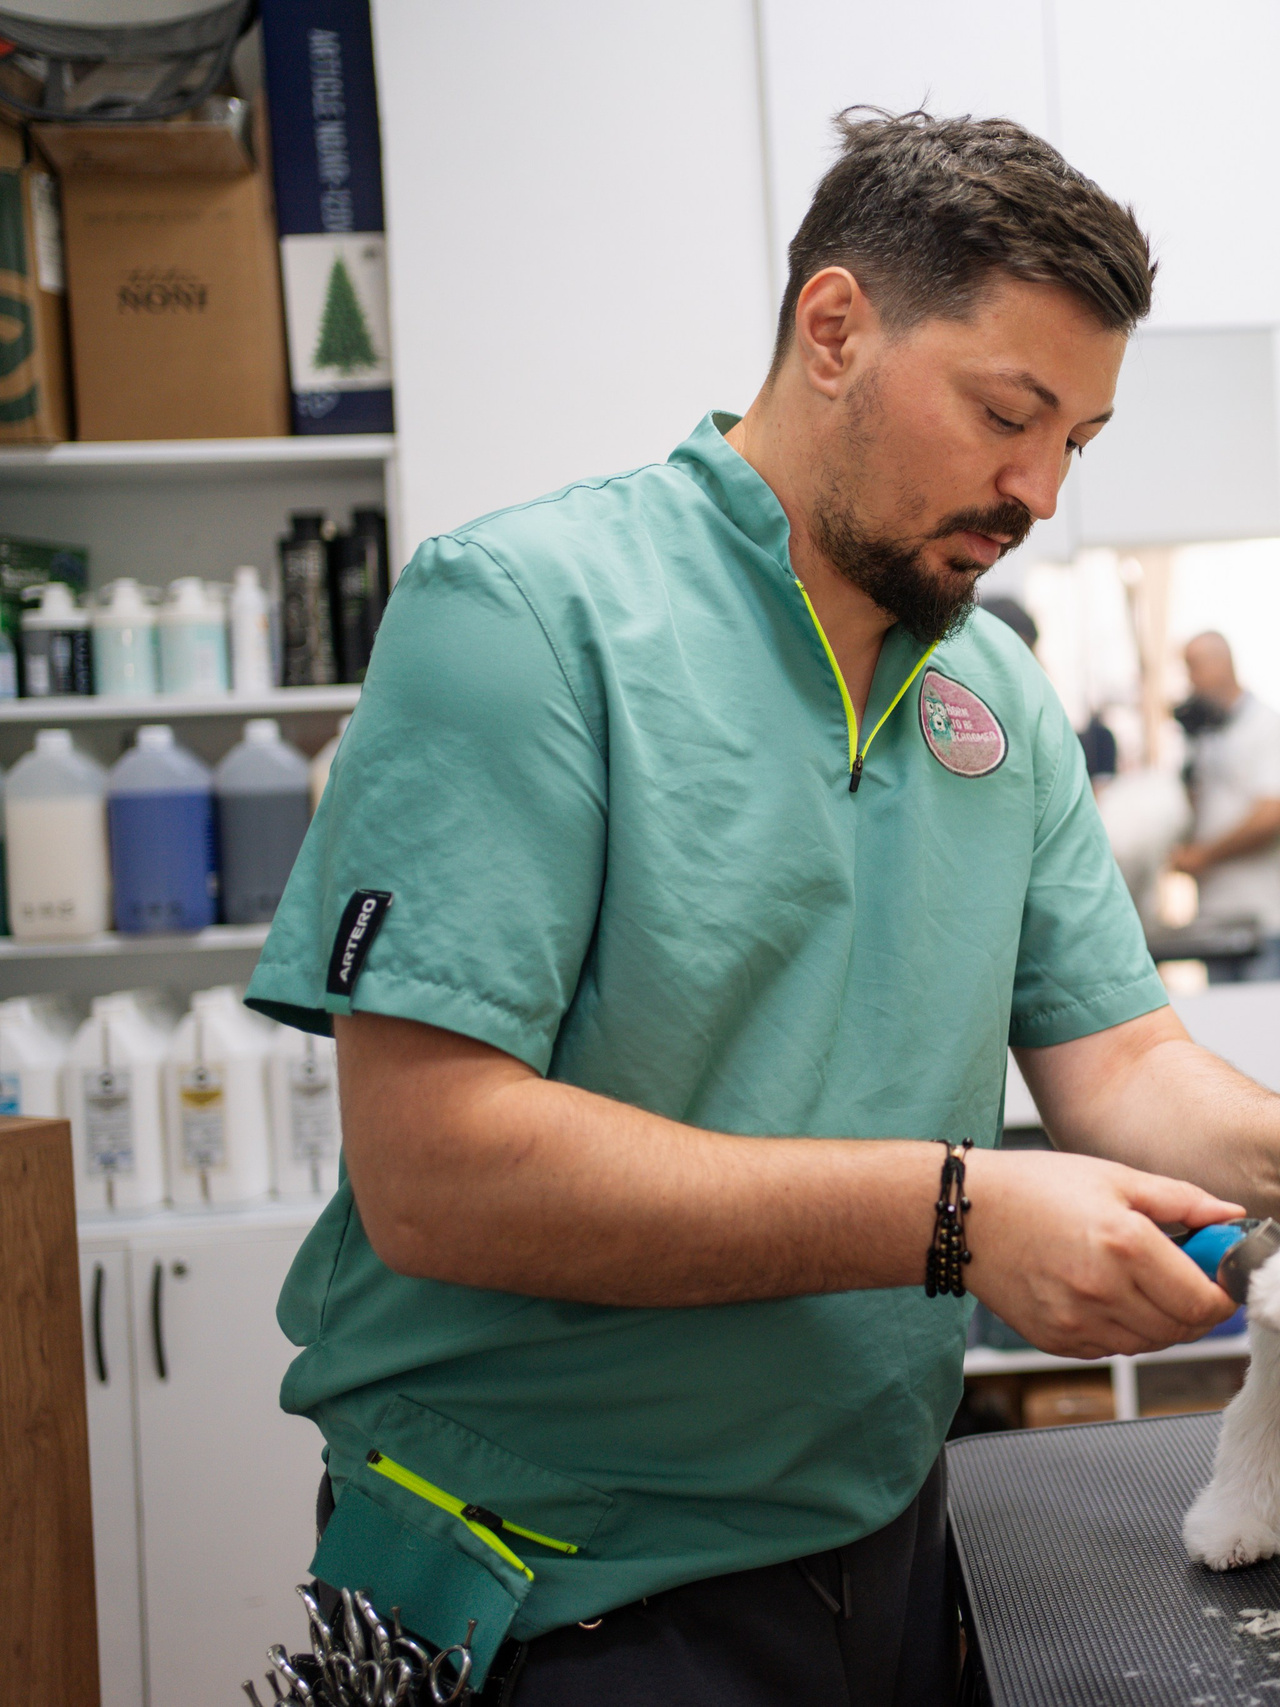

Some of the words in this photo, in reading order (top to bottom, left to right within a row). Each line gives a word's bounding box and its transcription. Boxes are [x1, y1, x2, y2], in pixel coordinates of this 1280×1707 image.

[946, 703, 970, 718] BORN
[951, 718, 962, 730] TO
[962, 719, 974, 731] BE
[339, 898, 378, 983] ARTERO
